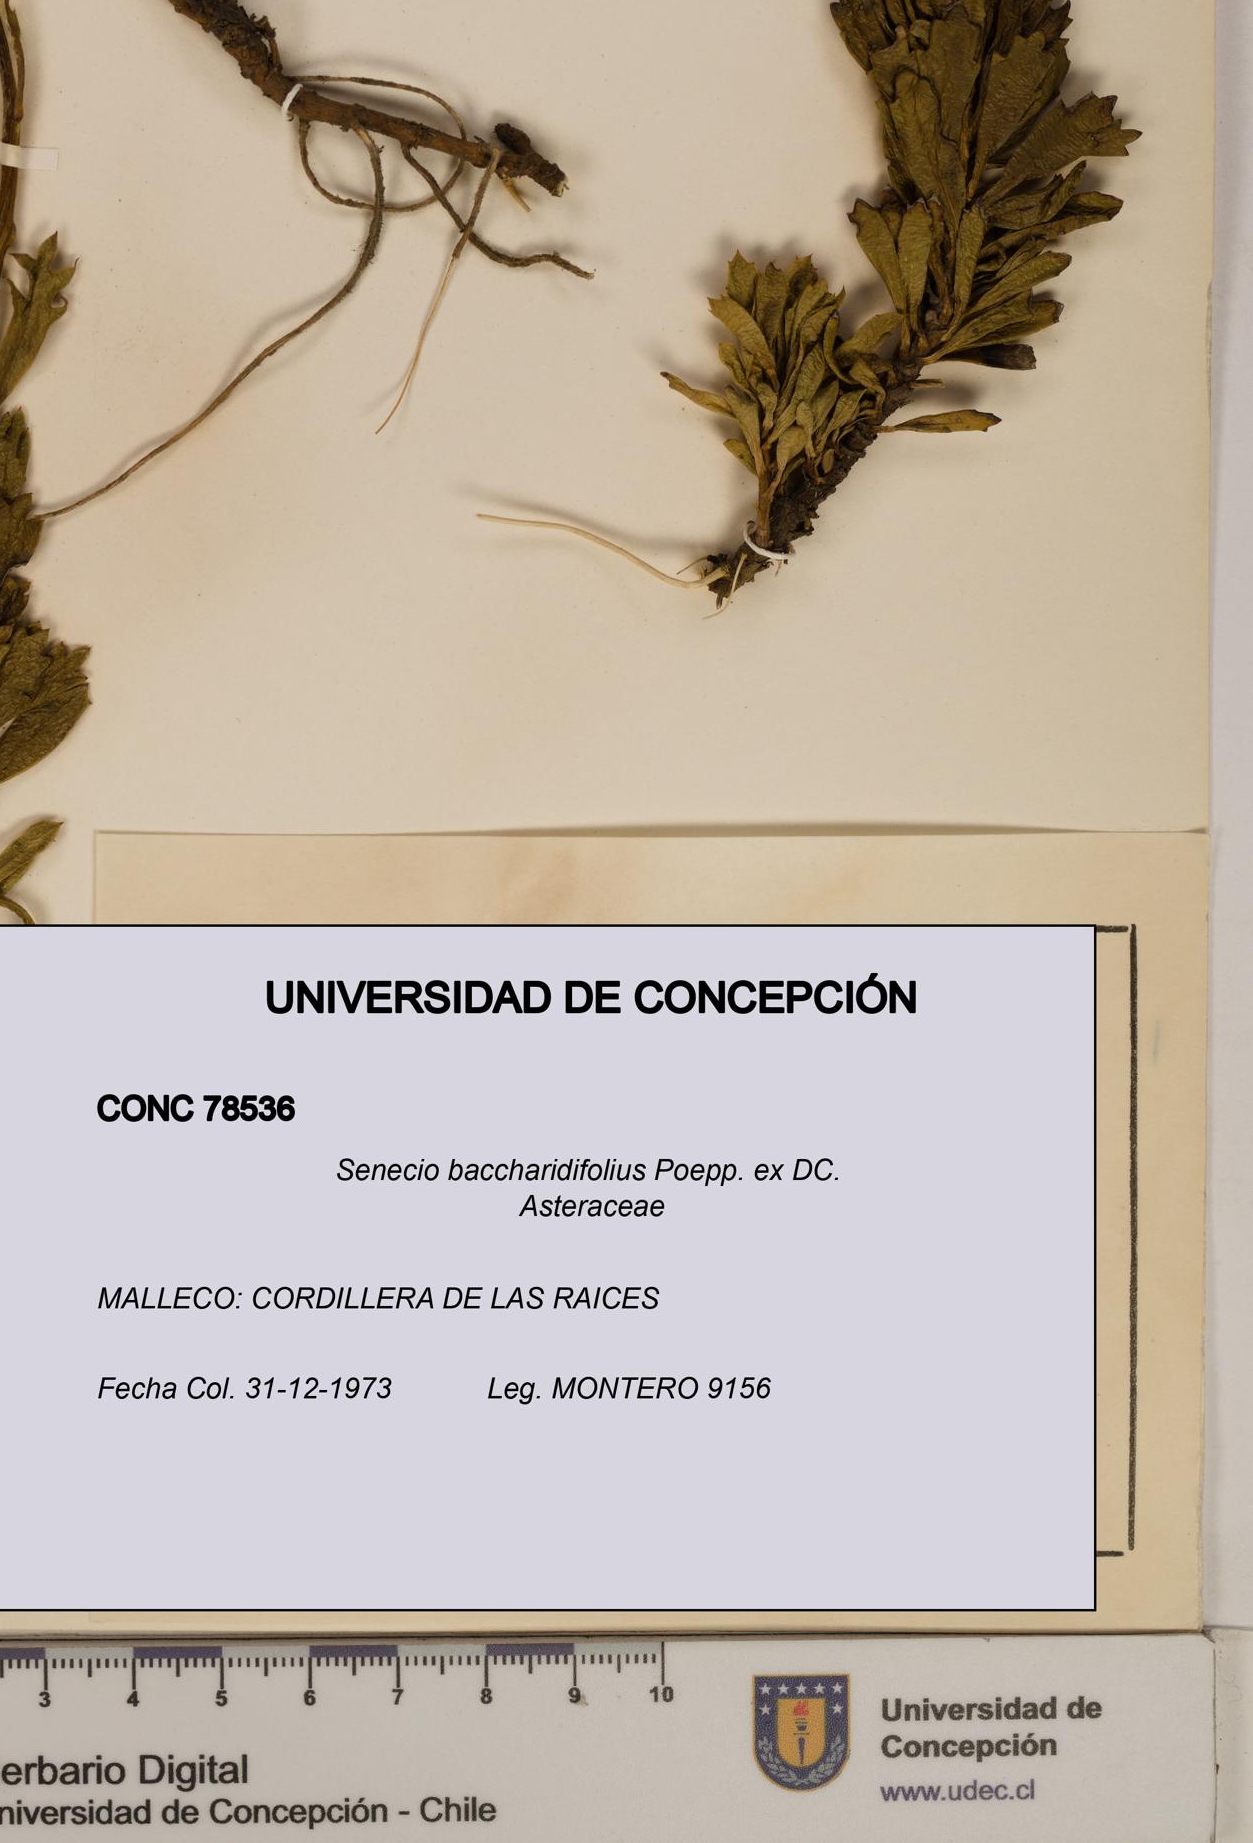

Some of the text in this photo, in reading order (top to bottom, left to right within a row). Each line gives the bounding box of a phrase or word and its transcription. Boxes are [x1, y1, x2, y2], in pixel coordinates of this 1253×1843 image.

[38, 1691, 52, 1708] 3
[126, 1690, 140, 1708] 4
[215, 1690, 228, 1708] 5
[303, 1689, 317, 1707] 6
[391, 1688, 404, 1706] 7
[480, 1688, 494, 1705] 8
[567, 1686, 582, 1704] 9
[649, 1685, 675, 1704] 10
[880, 1695, 1103, 1723] Universidad de
[880, 1732, 1058, 1763] Concepción
[139, 1754, 249, 1792] Digital
[879, 1779, 1036, 1803] www.udec.cl
[161, 1798, 200, 1825] de
[209, 1797, 389, 1831] Concepción
[419, 1796, 498, 1824] Chile
